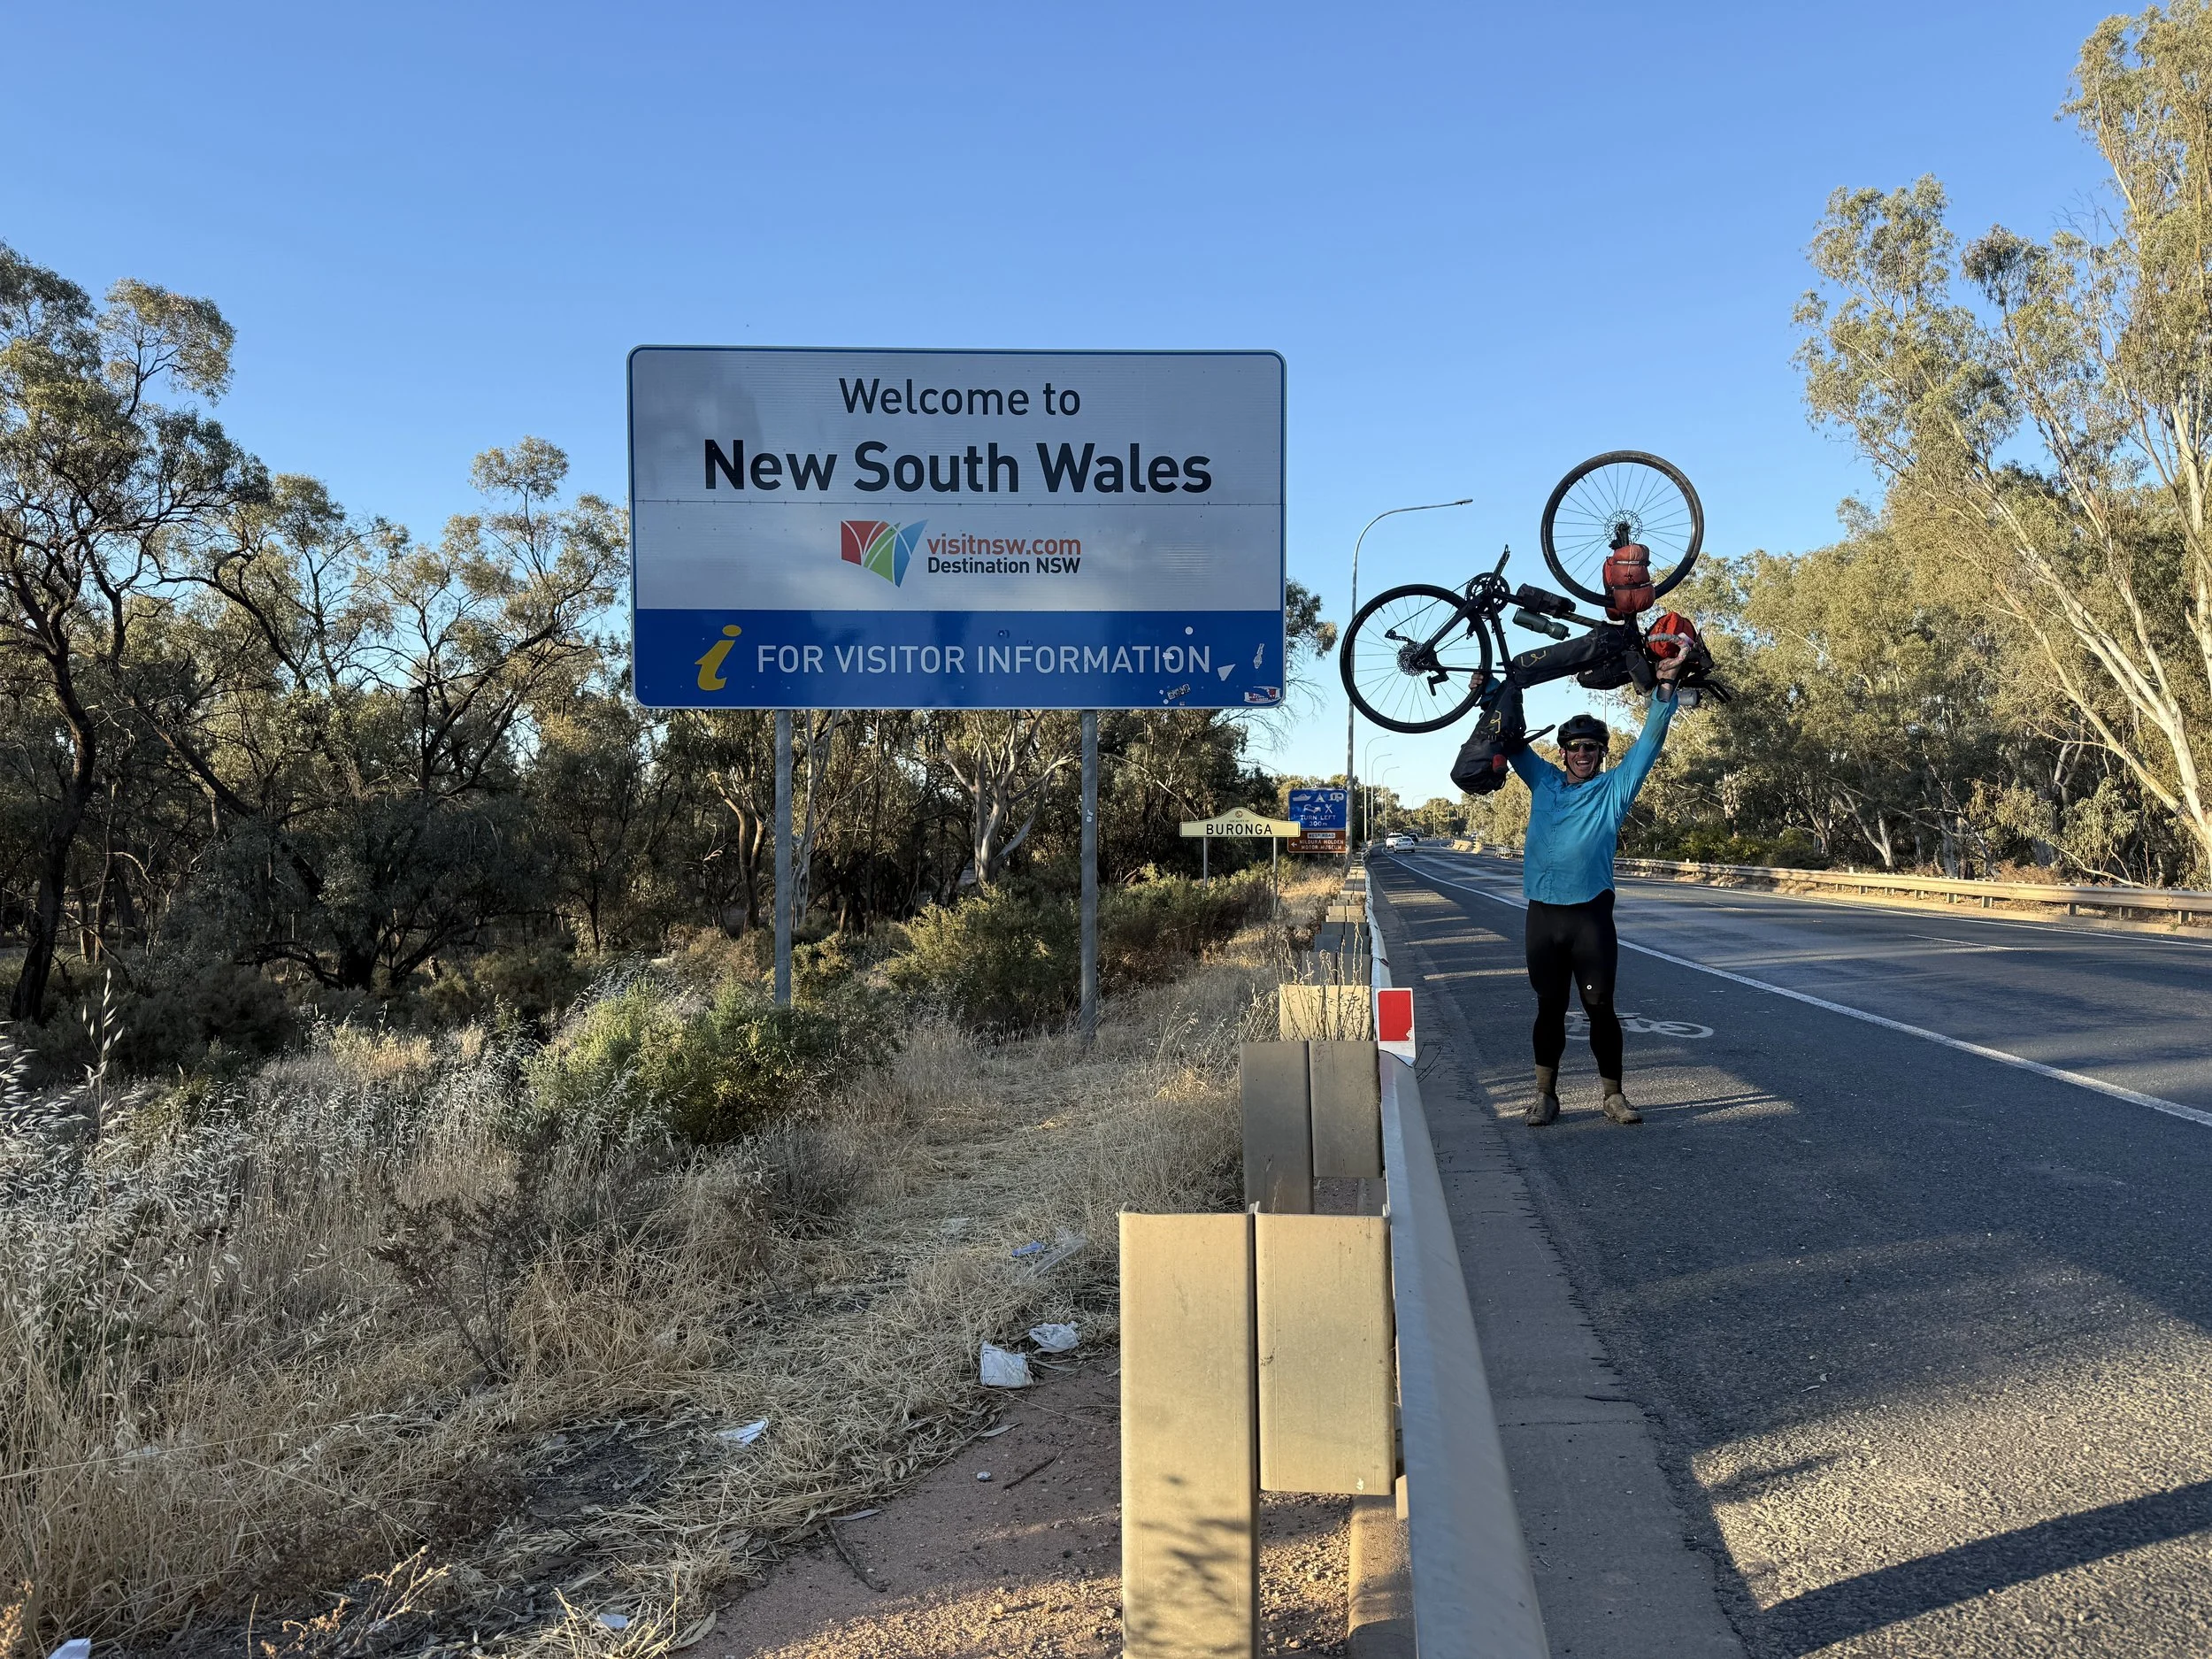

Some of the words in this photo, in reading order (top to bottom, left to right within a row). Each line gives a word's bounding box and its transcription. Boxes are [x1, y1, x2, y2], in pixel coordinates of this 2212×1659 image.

[839, 378, 1029, 416] Welcome
[1043, 382, 1080, 416] to
[705, 439, 837, 491] New
[854, 441, 1019, 493] South
[1036, 442, 1212, 494] Wales
[926, 534, 1081, 557] visitnsw.com
[927, 557, 1030, 574] Destination
[1036, 557, 1081, 574] NSW
[758, 645, 824, 673] FOR
[834, 645, 965, 673] VISITOR
[978, 645, 1210, 674] INFORMATION
[1206, 824, 1272, 834] BURONGA
